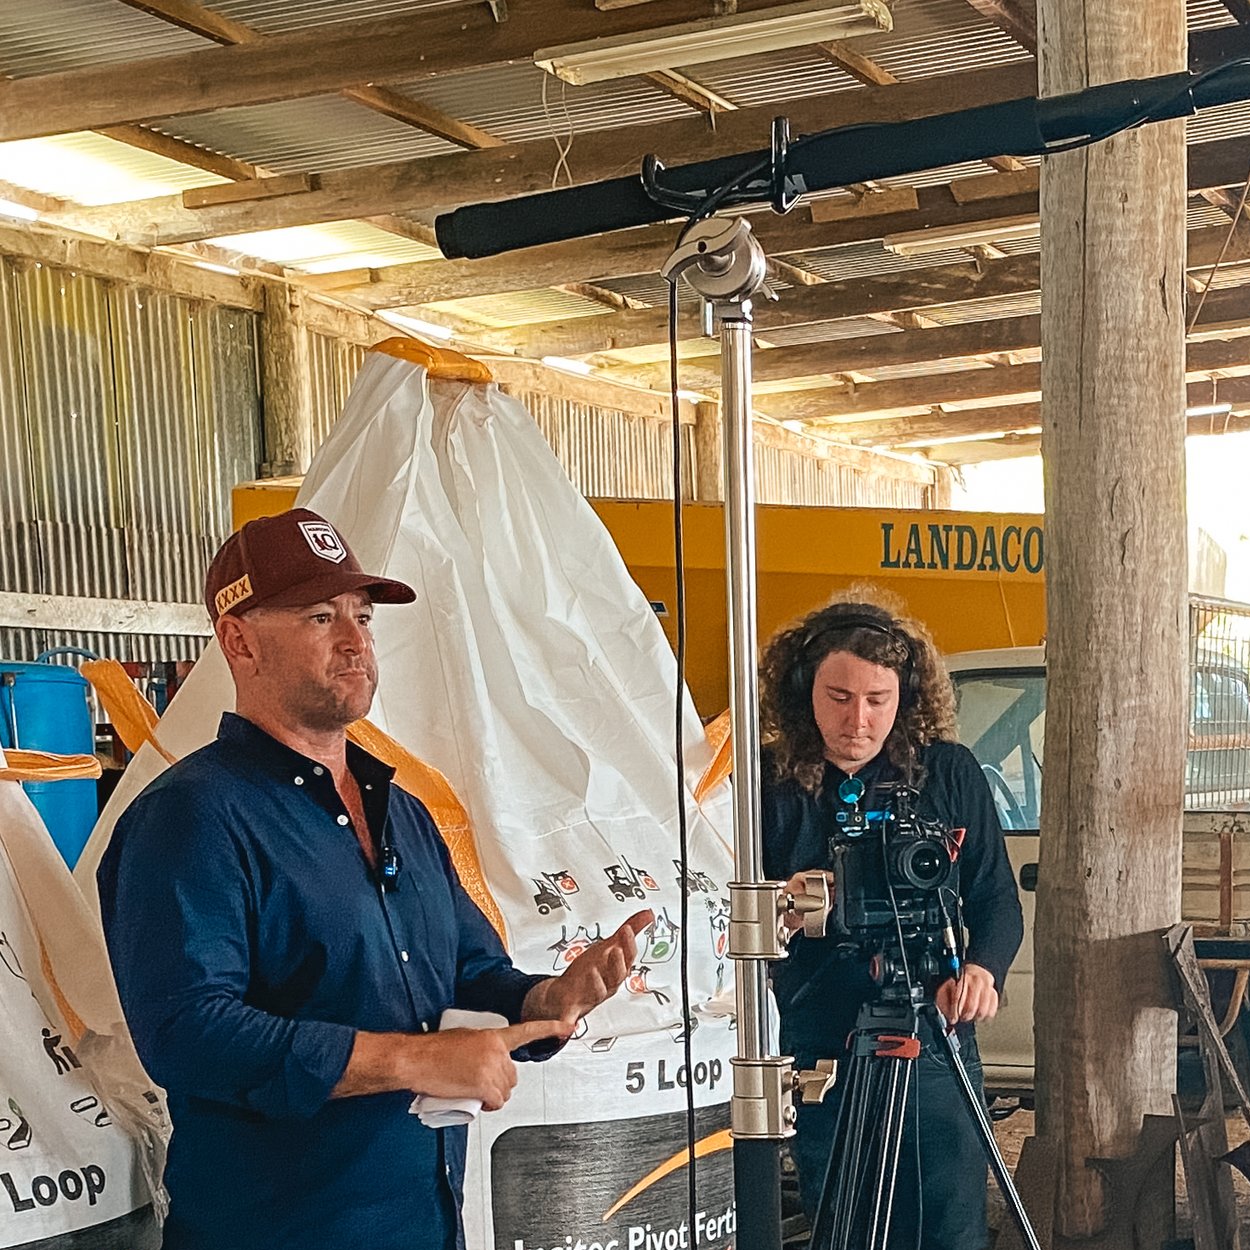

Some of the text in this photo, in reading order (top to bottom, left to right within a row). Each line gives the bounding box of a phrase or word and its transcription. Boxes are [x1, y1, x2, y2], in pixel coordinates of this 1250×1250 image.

[880, 523, 1044, 573] LANDACO
[217, 579, 249, 612] XXXX
[625, 1058, 722, 1093] 5 Loop
[0, 1164, 106, 1213] Loop
